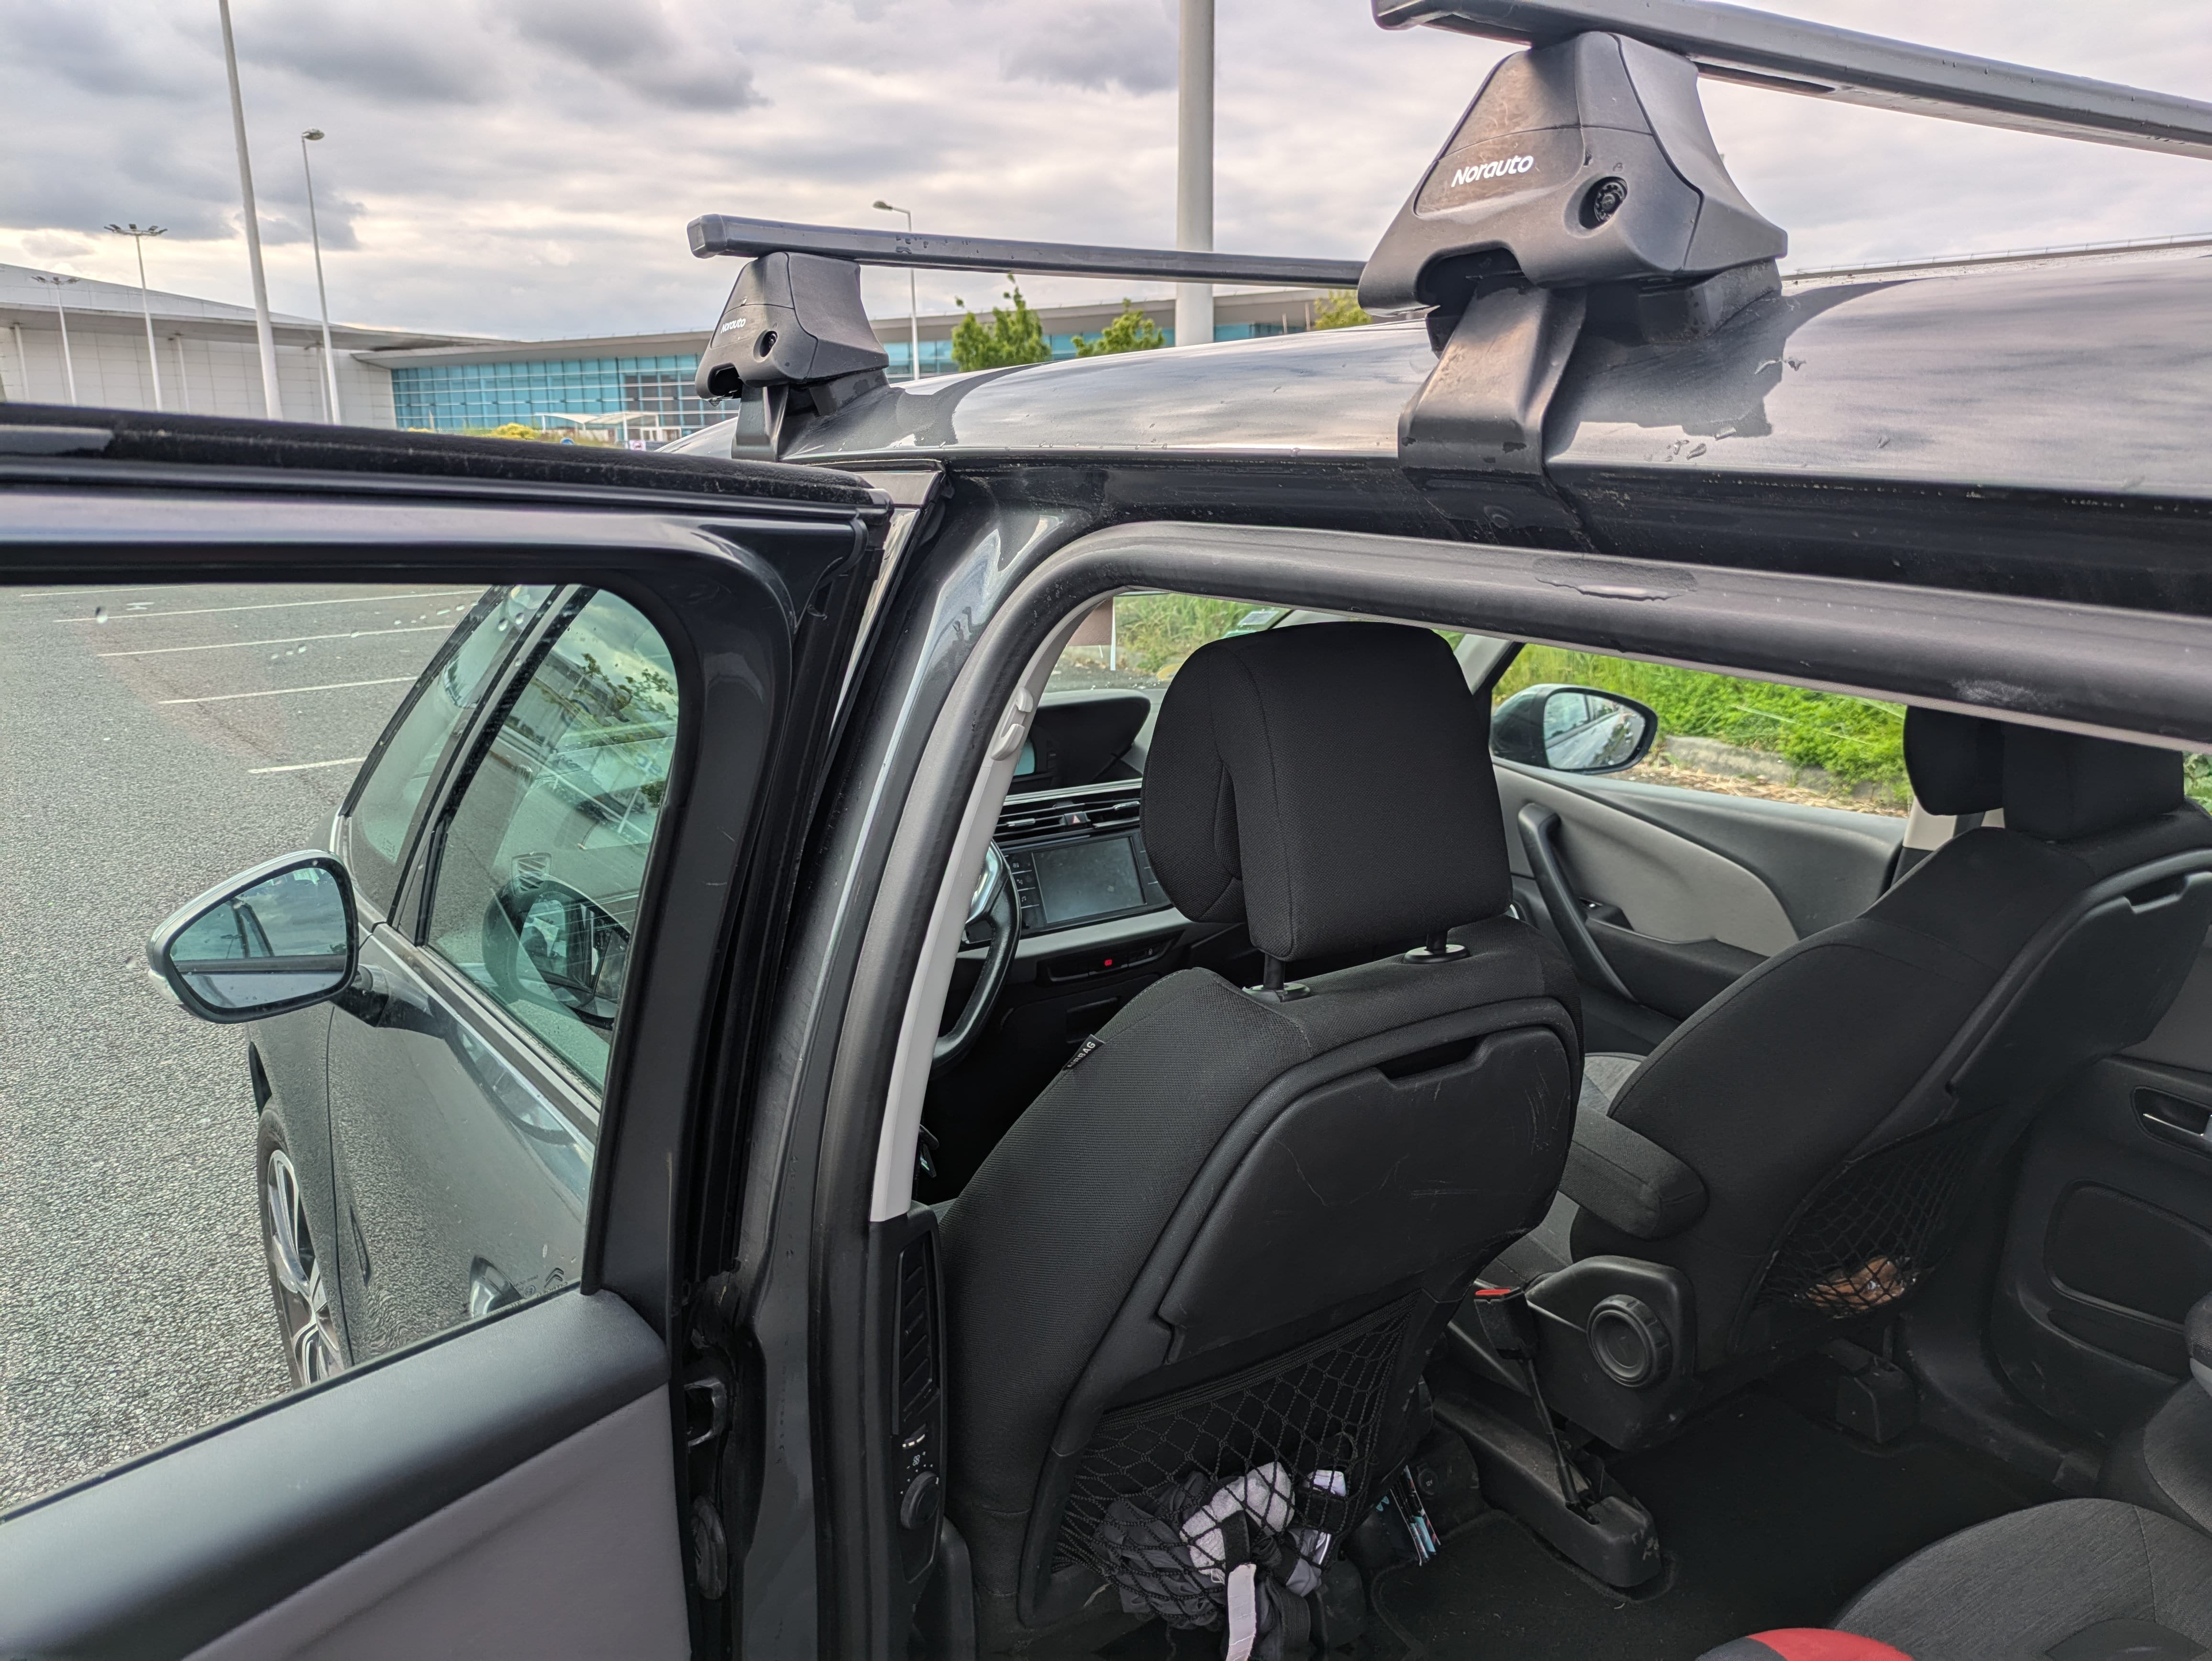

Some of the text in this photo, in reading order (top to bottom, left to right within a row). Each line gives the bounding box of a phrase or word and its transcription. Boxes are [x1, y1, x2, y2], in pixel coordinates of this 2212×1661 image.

[1451, 155, 1534, 187] Norauto
[720, 318, 746, 333] Norauto
[1067, 1041, 1096, 1068] AIRBAG
